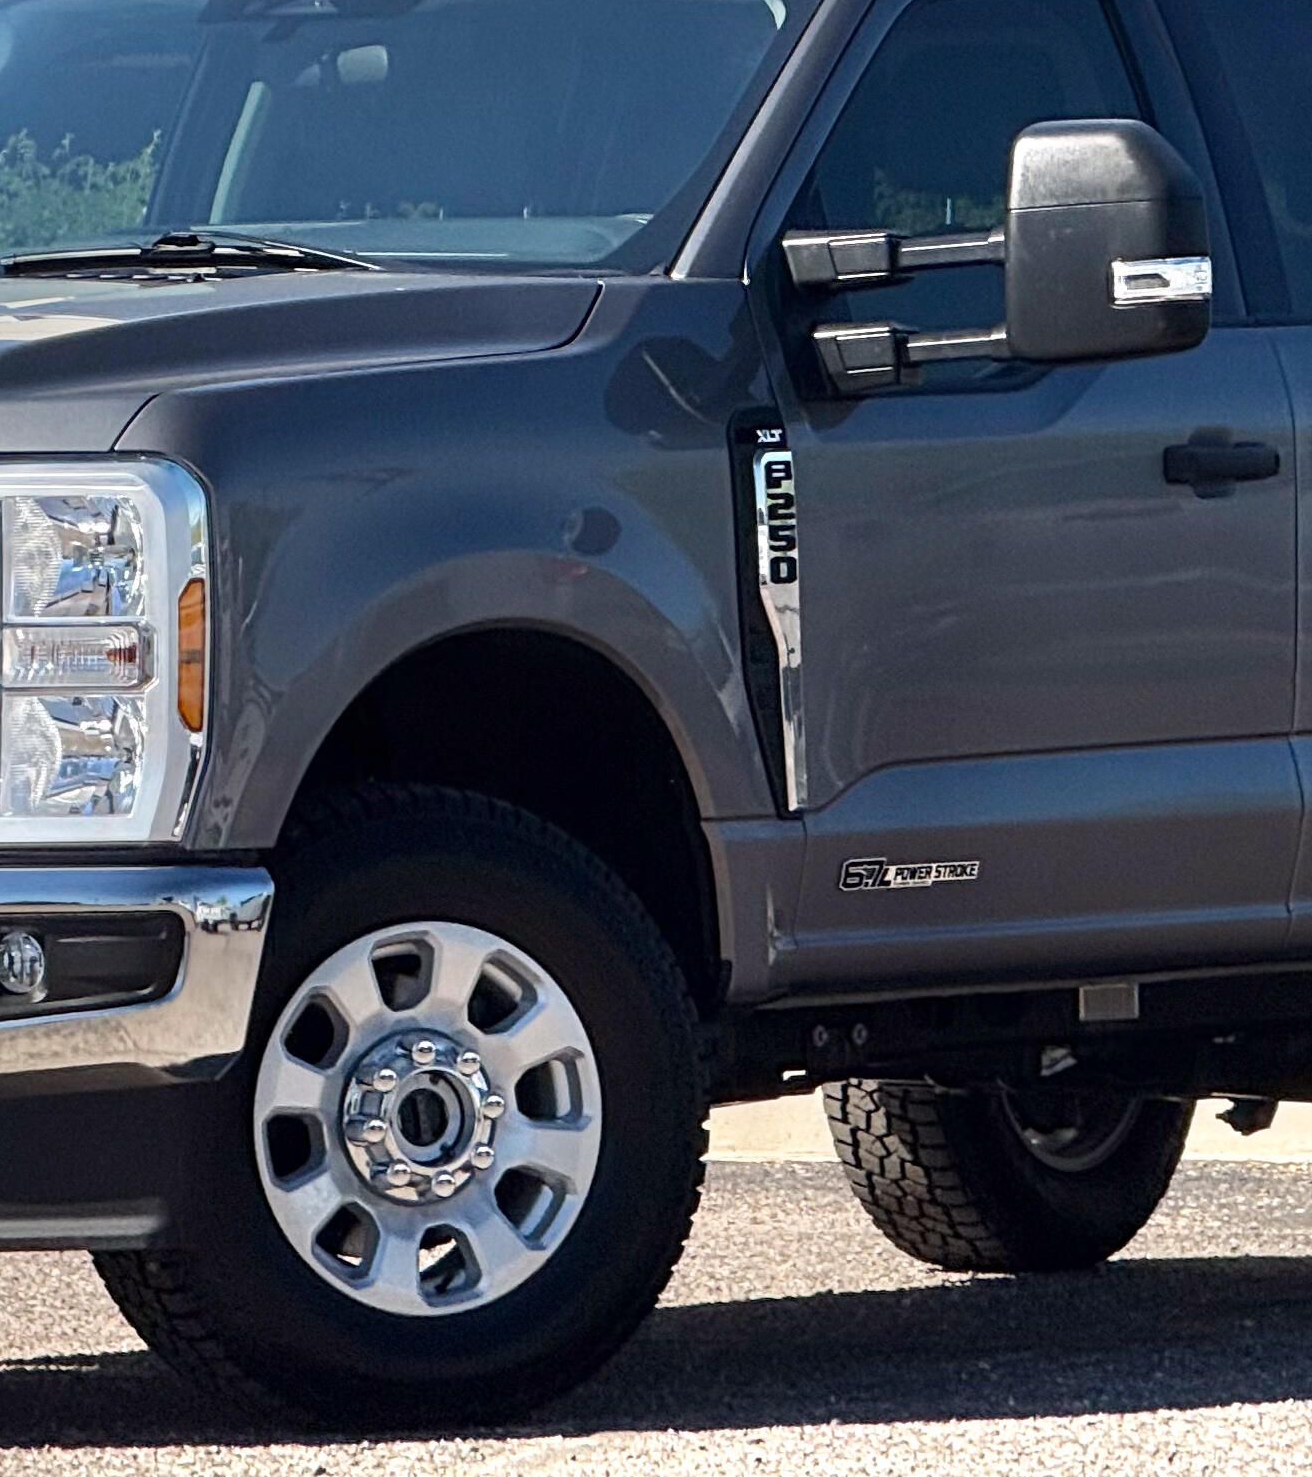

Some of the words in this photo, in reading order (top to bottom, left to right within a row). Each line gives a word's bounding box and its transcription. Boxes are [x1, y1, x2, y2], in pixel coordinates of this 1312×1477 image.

[756, 428, 783, 444] XLT
[764, 460, 798, 585] F250
[893, 865, 933, 881] POWER
[933, 863, 978, 879] STROKE
